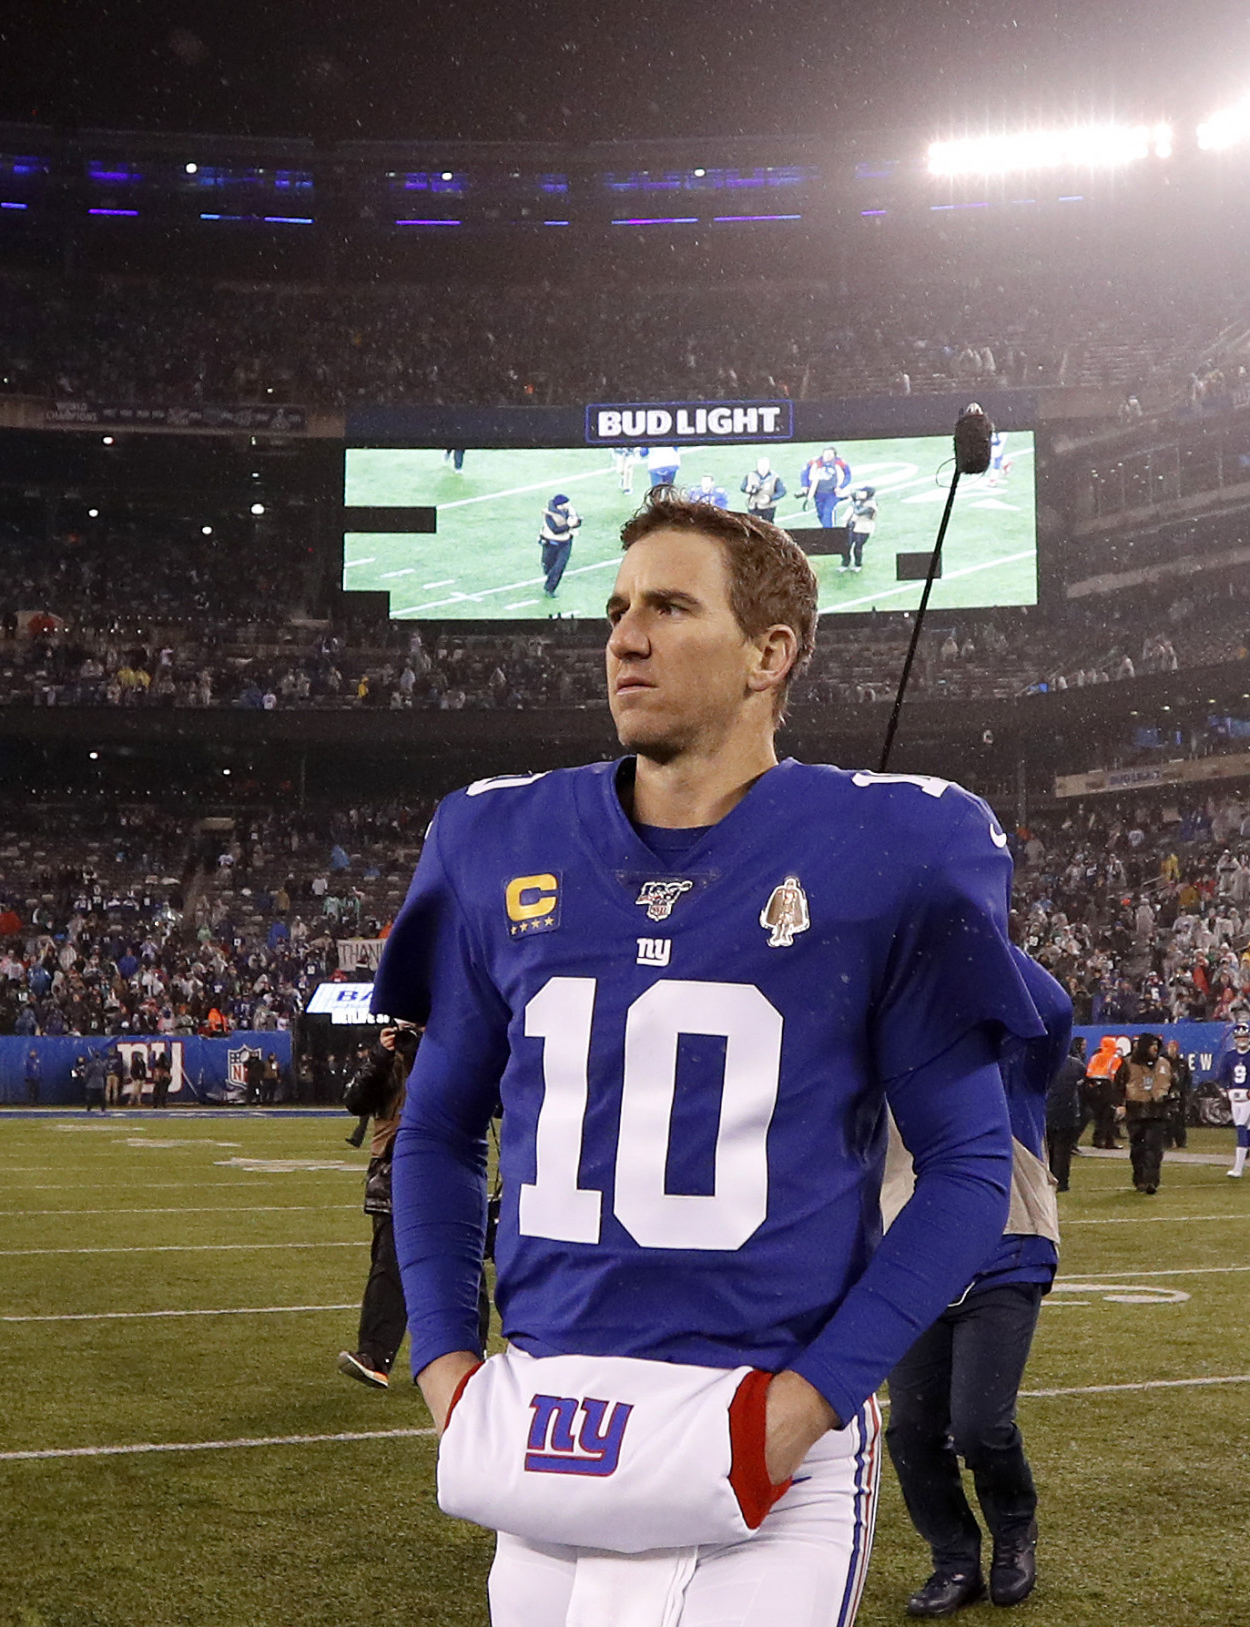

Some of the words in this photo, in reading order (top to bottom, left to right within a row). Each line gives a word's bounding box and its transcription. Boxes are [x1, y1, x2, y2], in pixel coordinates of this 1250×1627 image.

[598, 410, 673, 436] BUD
[676, 407, 780, 435] LIGHT
[506, 873, 558, 921] C
[339, 942, 385, 964] THAN
[1179, 1053, 1213, 1071] EW
[1234, 1065, 1247, 1084] 9
[519, 976, 784, 1251] 10
